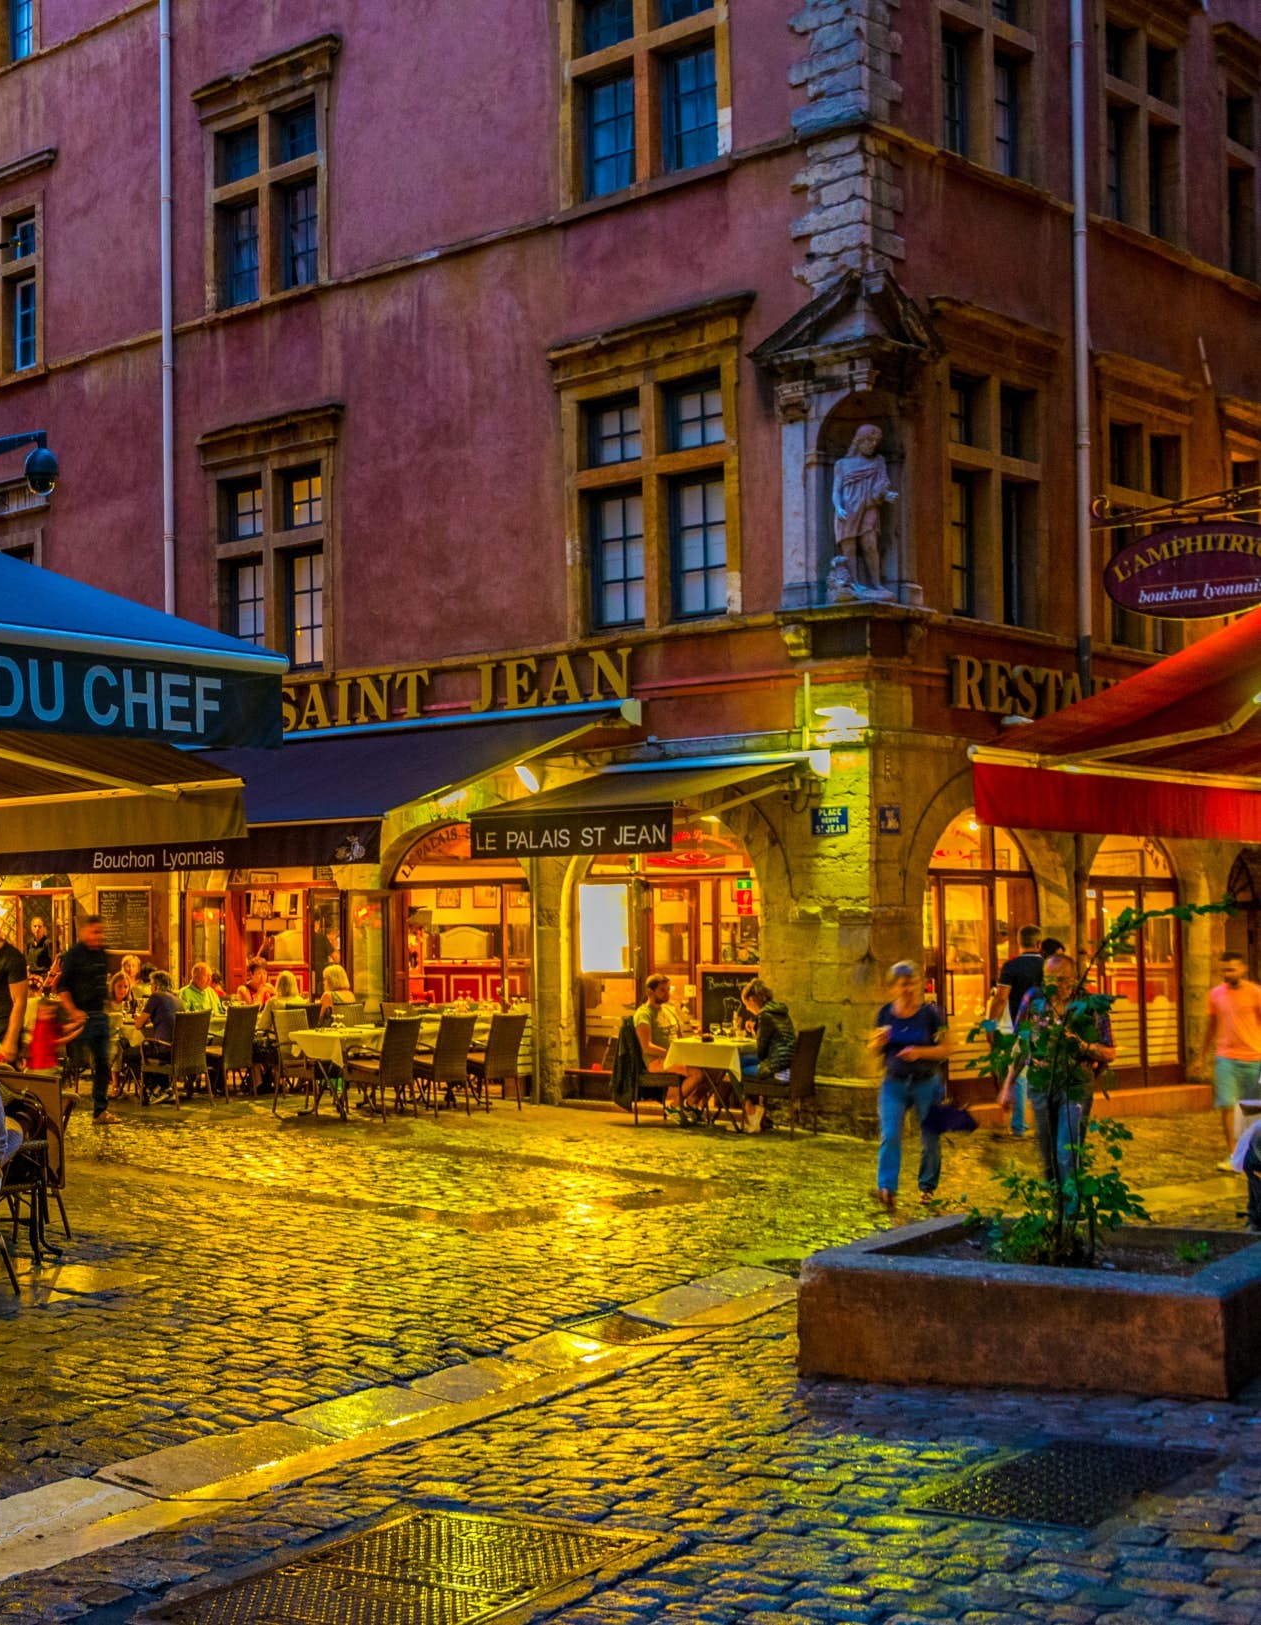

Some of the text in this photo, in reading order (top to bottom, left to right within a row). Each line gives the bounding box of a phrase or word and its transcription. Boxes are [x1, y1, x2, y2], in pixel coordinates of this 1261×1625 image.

[1113, 533, 1261, 583] L'AMPHITRY
[1138, 586, 1197, 603] bouchon
[83, 664, 223, 735] CHEF
[282, 648, 633, 732] SAINT JEAN
[818, 807, 842, 817] PLACE
[475, 832, 497, 851] LE
[506, 828, 571, 850] PALAIS
[580, 827, 606, 848] ST
[614, 824, 667, 846] JEAN
[825, 824, 847, 833] JEAN
[93, 847, 225, 871] Bouchon Lyonnais
